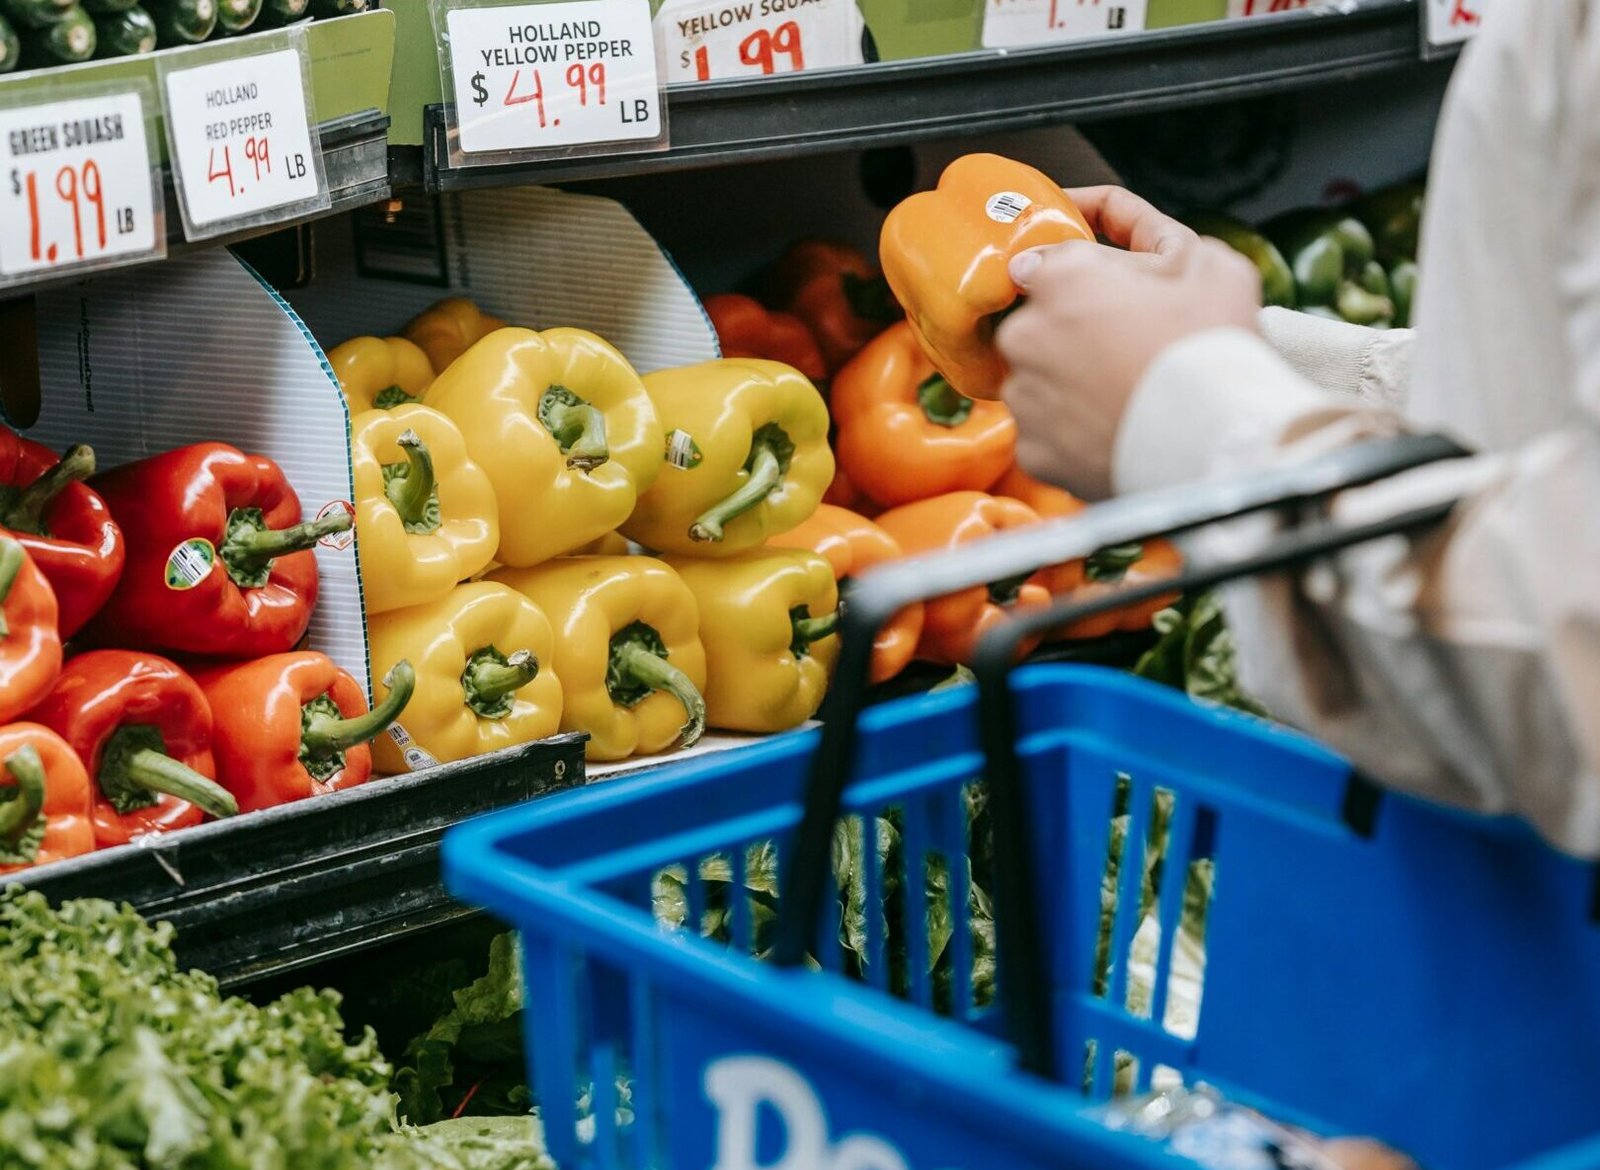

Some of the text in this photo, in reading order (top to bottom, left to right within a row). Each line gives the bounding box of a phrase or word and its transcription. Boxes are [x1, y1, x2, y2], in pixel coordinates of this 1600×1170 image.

[508, 20, 601, 44] HOLLAND
[677, 4, 754, 38] YELLOW
[480, 38, 634, 67] YELLOW PEPPER
[205, 82, 258, 108] HOLLAND
[205, 111, 273, 141] RED PEPPER
[619, 99, 649, 124] LB
[10, 113, 124, 156] GREEN SQUASH
[207, 136, 307, 198] 4.99 LB
[117, 207, 135, 234] LB
